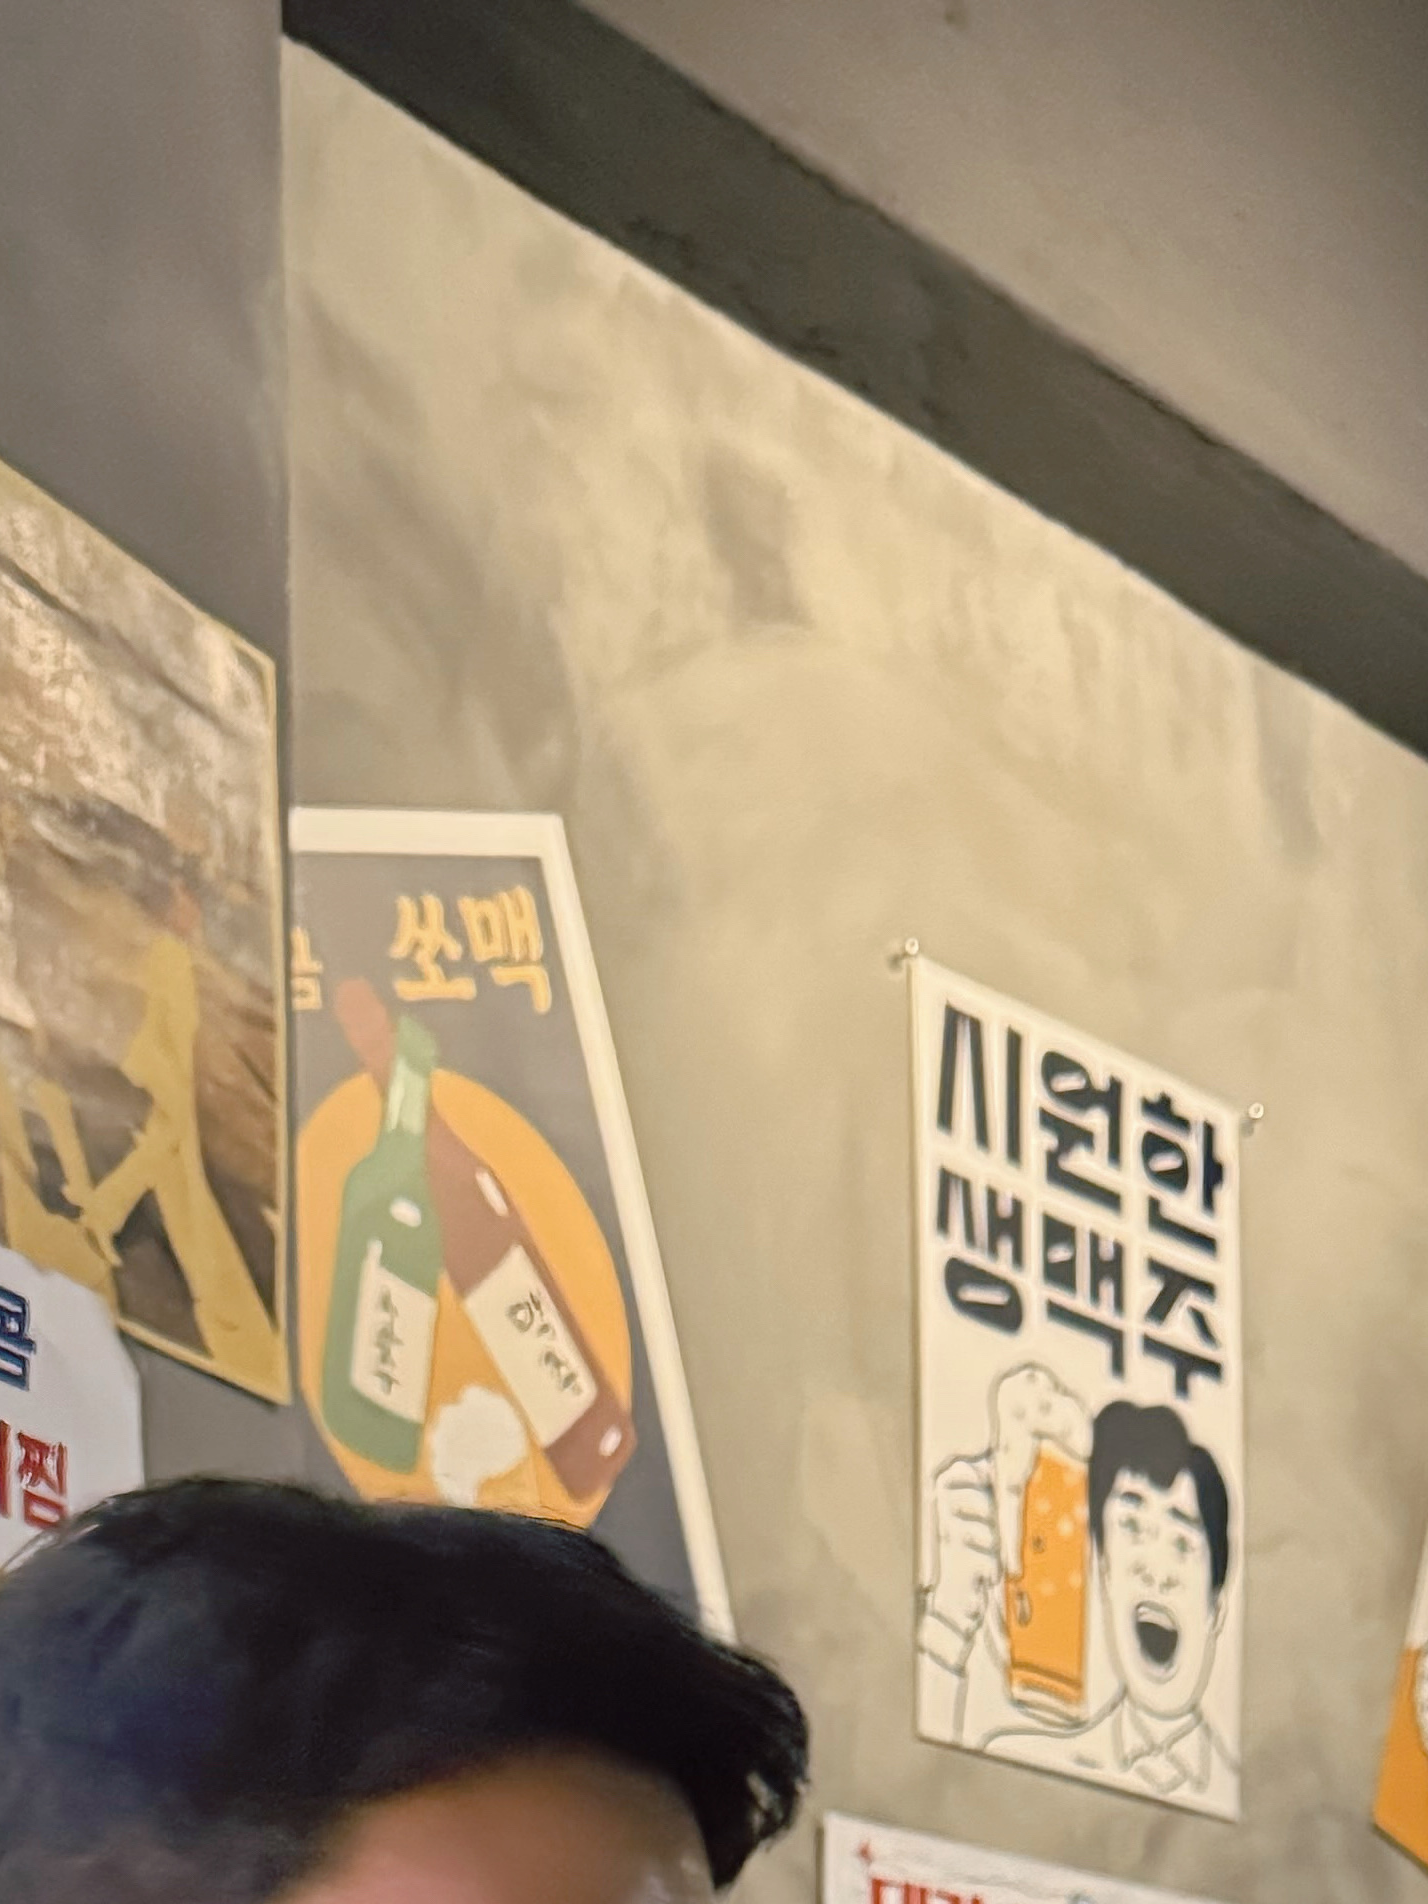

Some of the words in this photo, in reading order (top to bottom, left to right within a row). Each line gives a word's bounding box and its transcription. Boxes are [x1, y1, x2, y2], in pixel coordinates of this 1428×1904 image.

[388, 885, 552, 1015] 쏘맥
[936, 999, 1225, 1260] 시원한
[934, 1166, 1224, 1400] 생맥주
